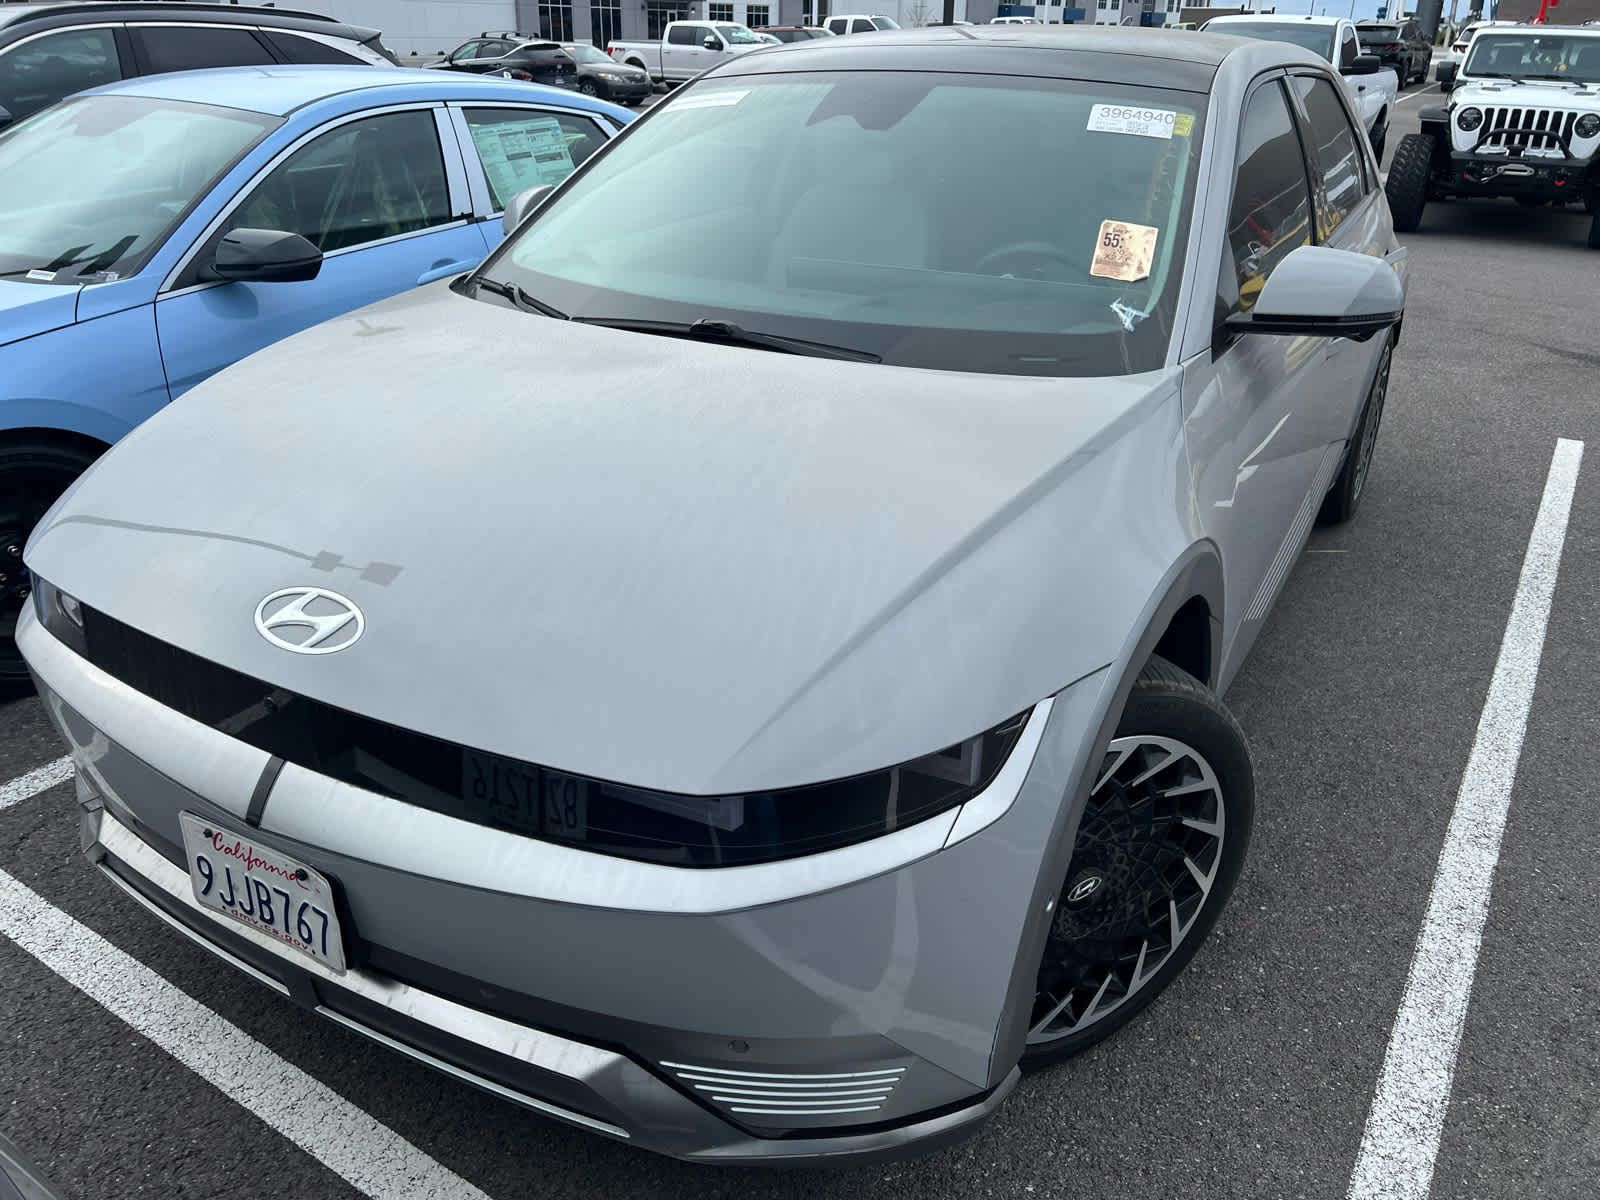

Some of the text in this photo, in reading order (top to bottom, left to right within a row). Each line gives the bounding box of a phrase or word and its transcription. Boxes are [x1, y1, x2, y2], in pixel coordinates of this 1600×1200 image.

[1100, 107, 1175, 125] 3964940
[212, 832, 304, 884] California
[196, 854, 328, 956] 9JJB767
